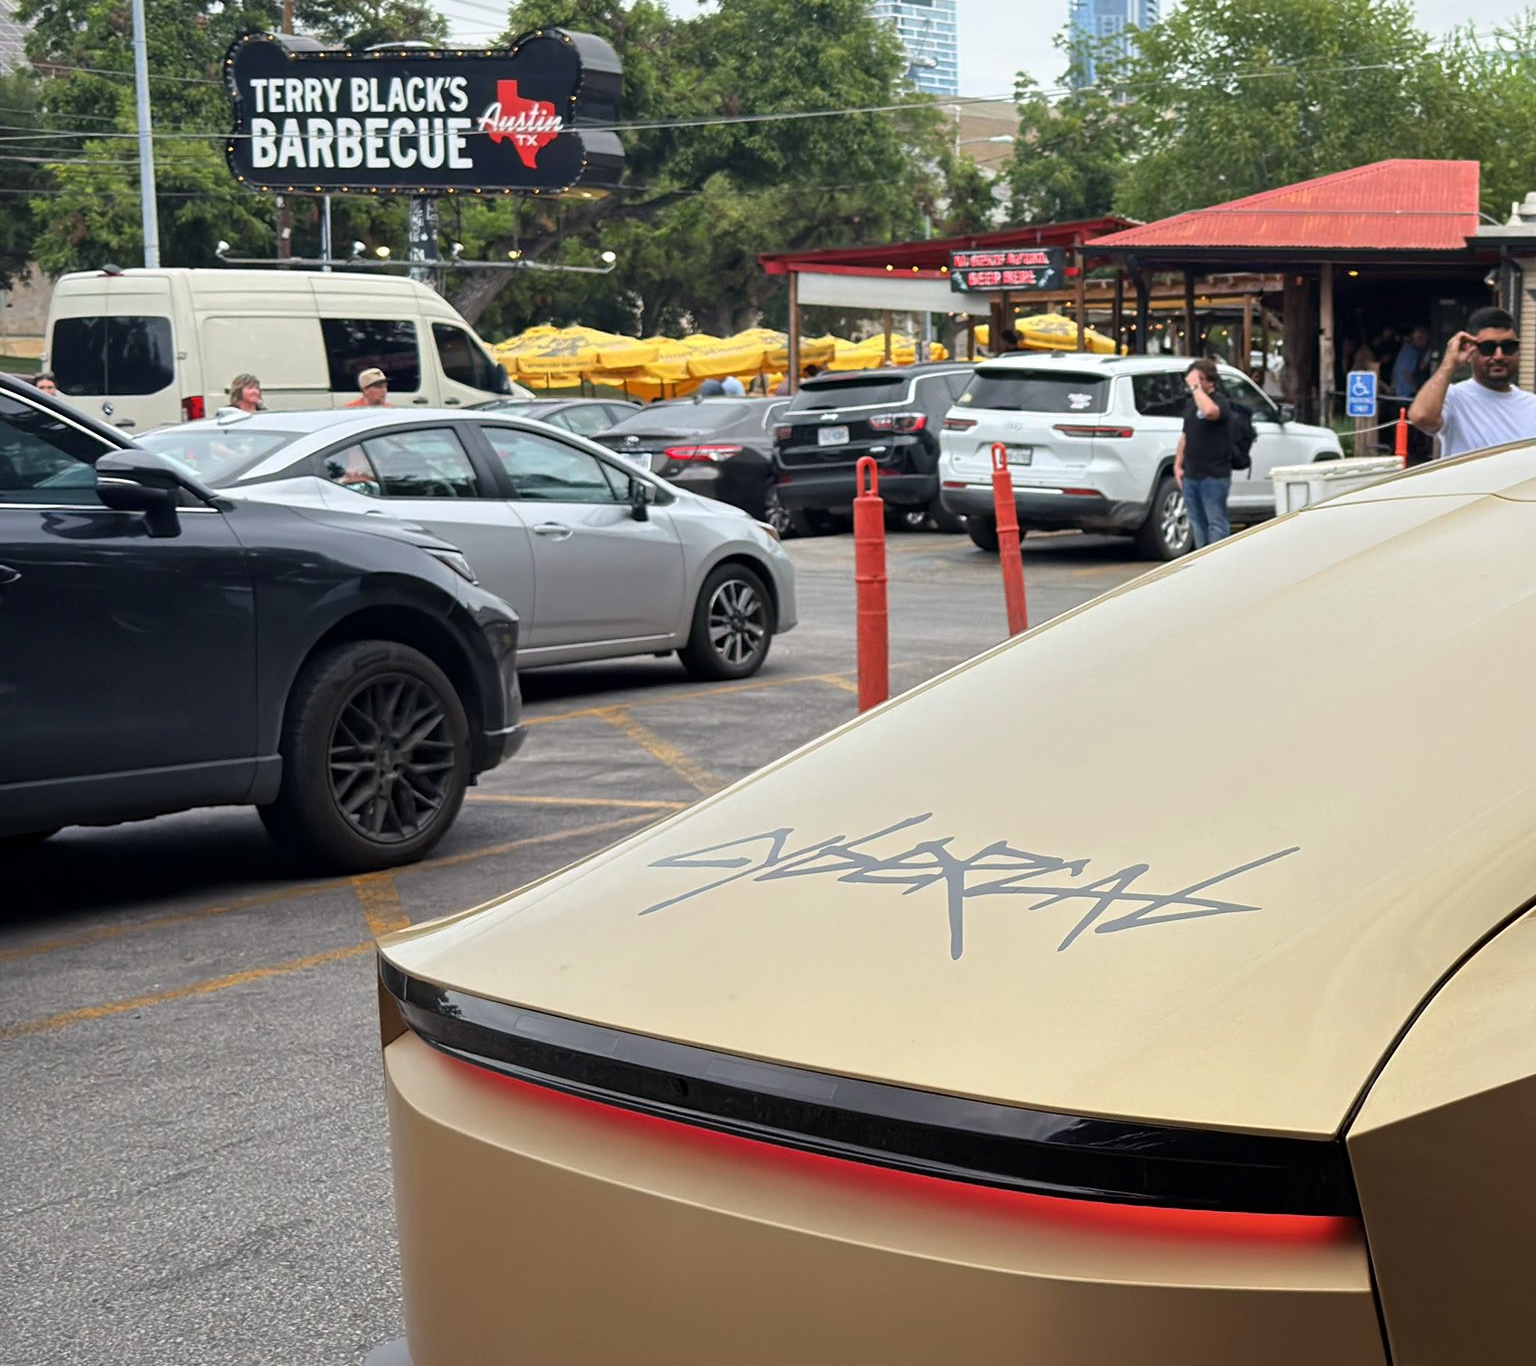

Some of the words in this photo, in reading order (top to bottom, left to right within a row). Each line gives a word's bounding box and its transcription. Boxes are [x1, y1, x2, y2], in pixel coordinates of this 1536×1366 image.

[250, 78, 342, 113] TERRY
[351, 76, 469, 113] BLACK'S
[476, 101, 565, 133] Austin
[251, 117, 473, 169] BARBECUE
[515, 134, 538, 146] TX
